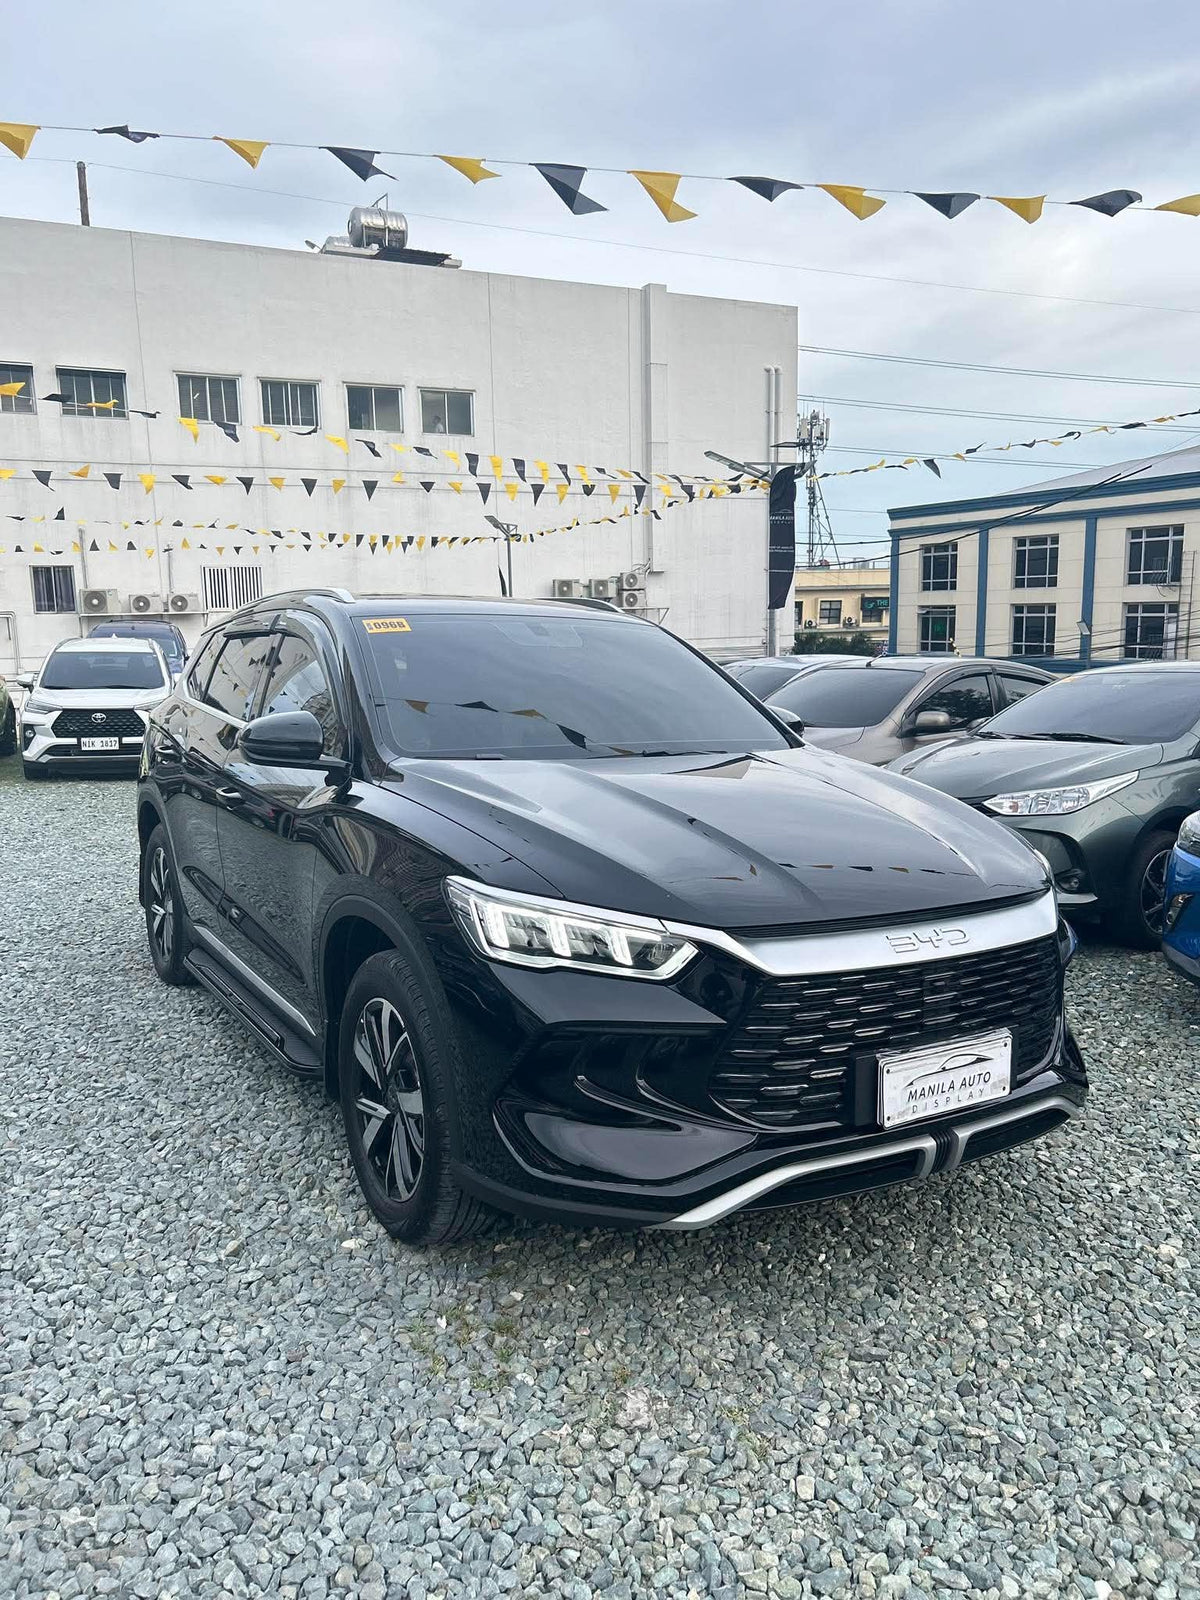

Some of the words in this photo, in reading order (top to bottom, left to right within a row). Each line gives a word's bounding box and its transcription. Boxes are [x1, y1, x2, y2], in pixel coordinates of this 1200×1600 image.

[82, 740, 96, 748] NIK
[885, 928, 971, 954] BYD
[907, 1079, 955, 1102] MANILA
[960, 1071, 992, 1087] AUTO
[911, 1088, 985, 1114] DISPLAY
